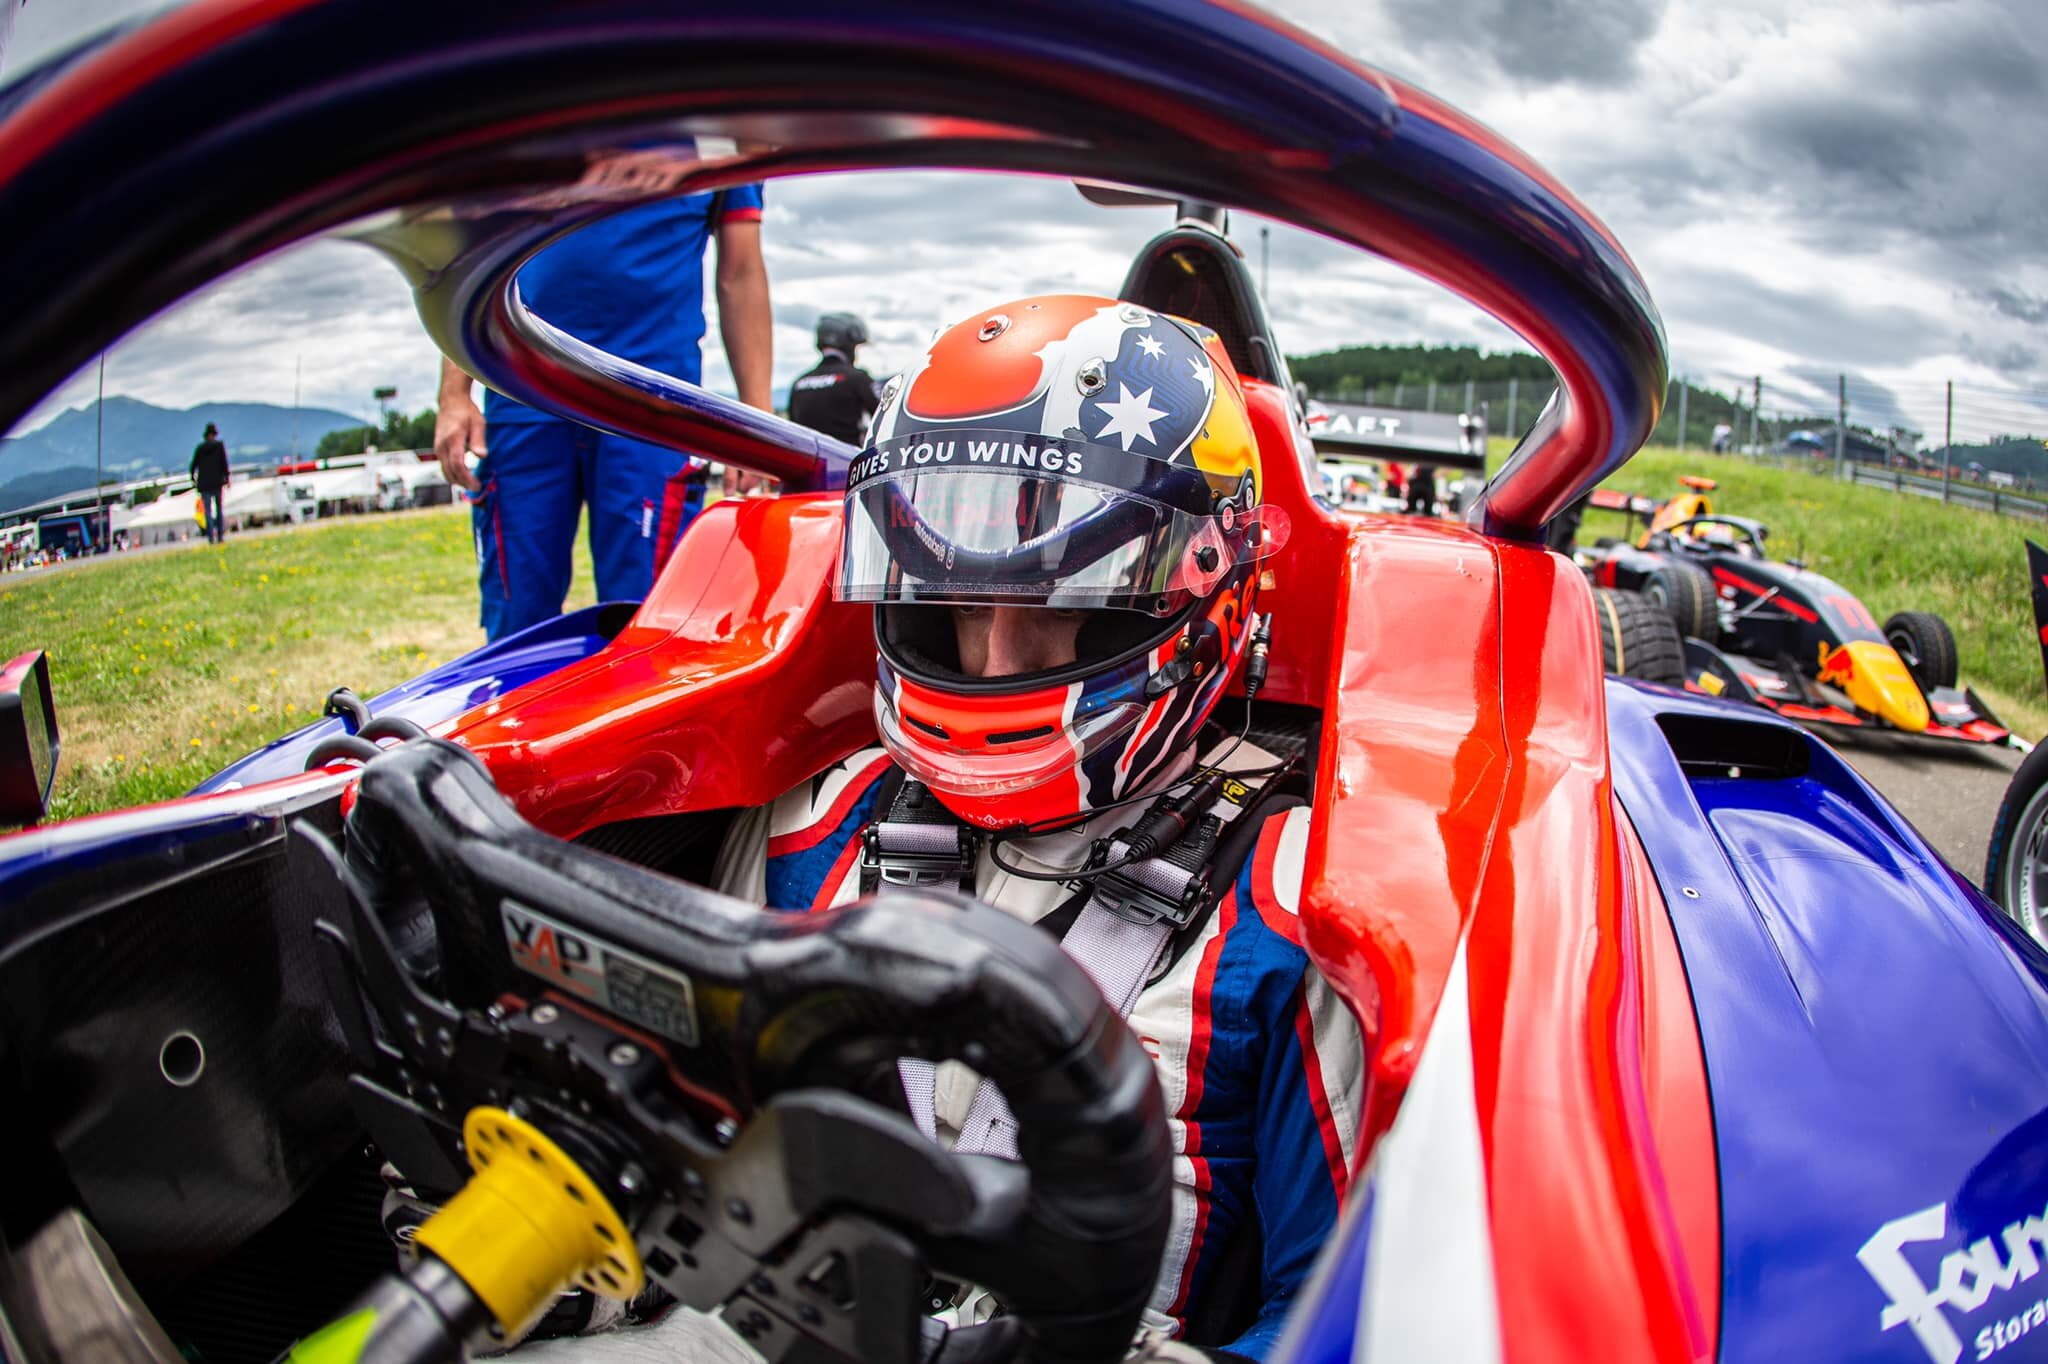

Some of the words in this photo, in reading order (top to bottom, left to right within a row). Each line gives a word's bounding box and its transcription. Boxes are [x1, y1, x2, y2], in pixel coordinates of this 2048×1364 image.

[850, 451, 890, 484] GIVES
[899, 441, 955, 466] YOU
[968, 441, 1084, 475] WINGS
[1974, 1299, 2048, 1362] Stora
